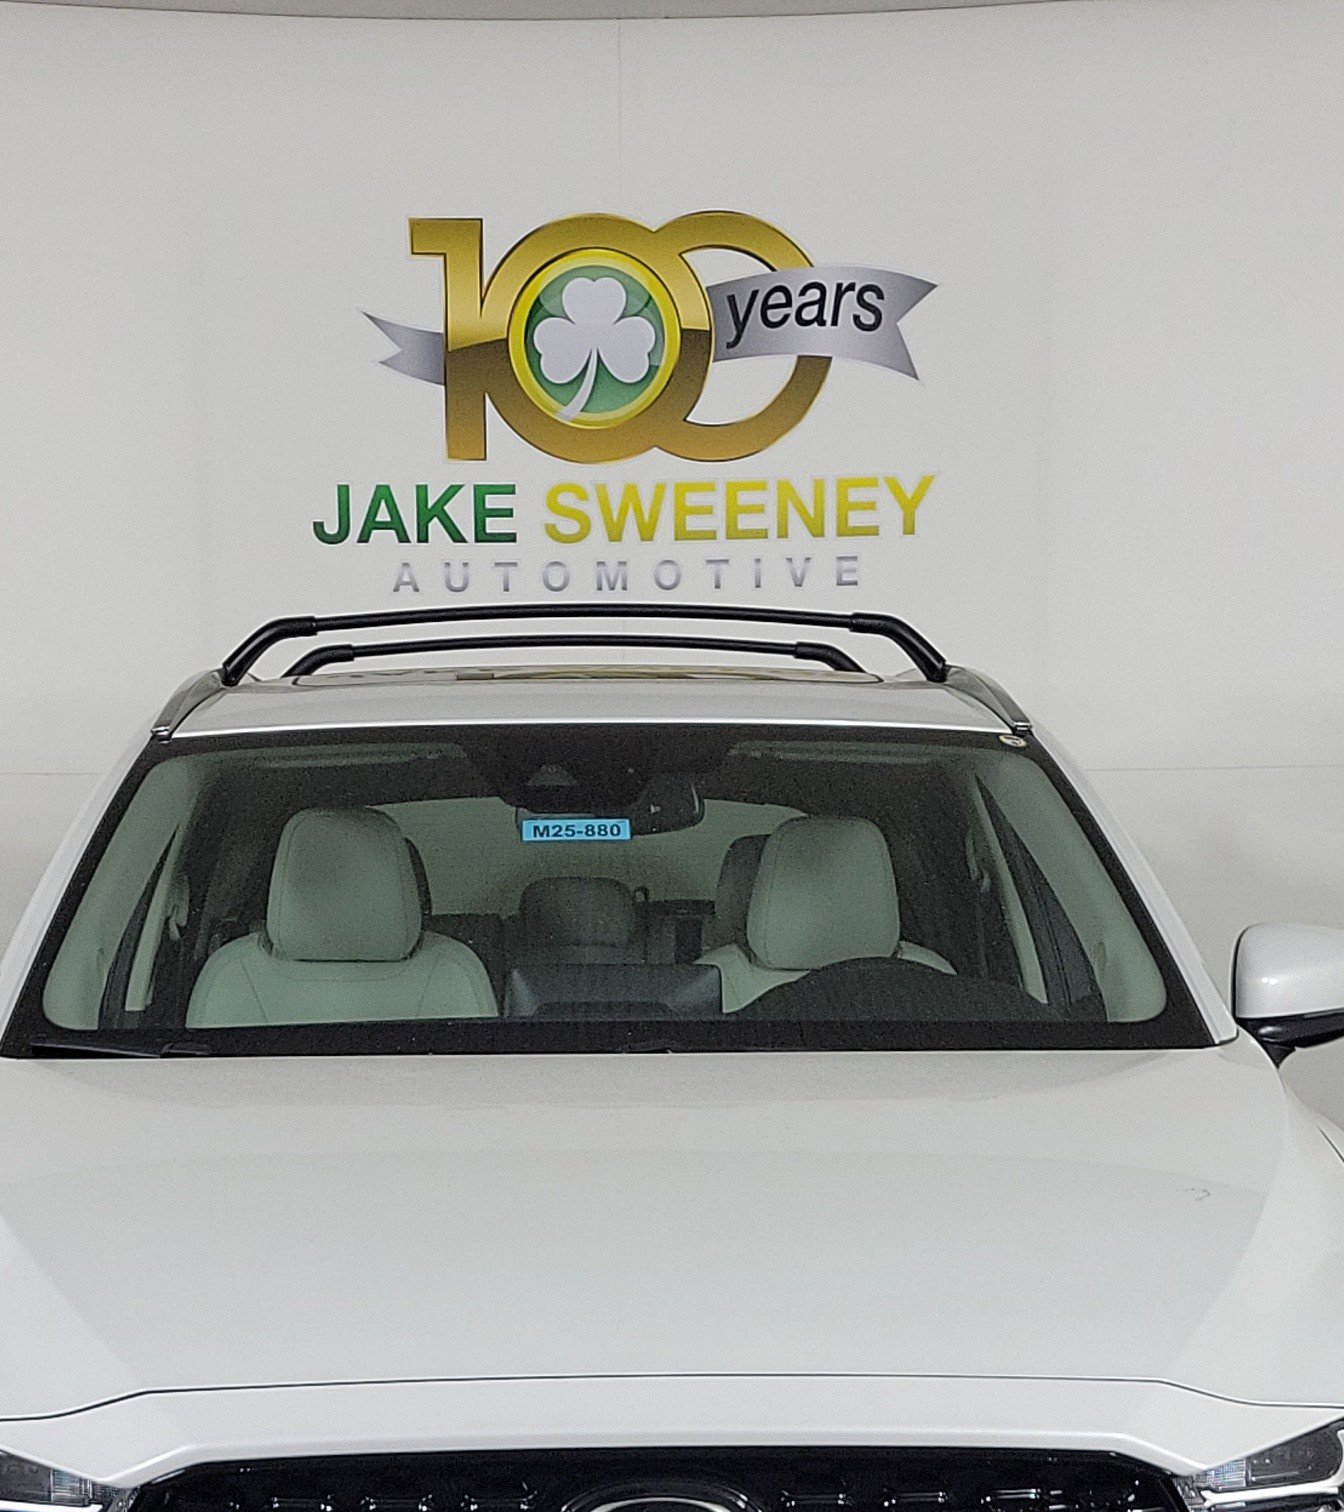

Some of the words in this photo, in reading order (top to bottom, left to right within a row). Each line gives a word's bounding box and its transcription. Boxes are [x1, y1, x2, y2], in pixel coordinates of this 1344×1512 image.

[409, 210, 832, 464] 100
[725, 281, 884, 349] years
[312, 484, 517, 544] JAKE
[544, 476, 935, 543] SWEENEY
[393, 556, 859, 594] AUTOMOTIVE
[533, 824, 621, 838] M25-880
